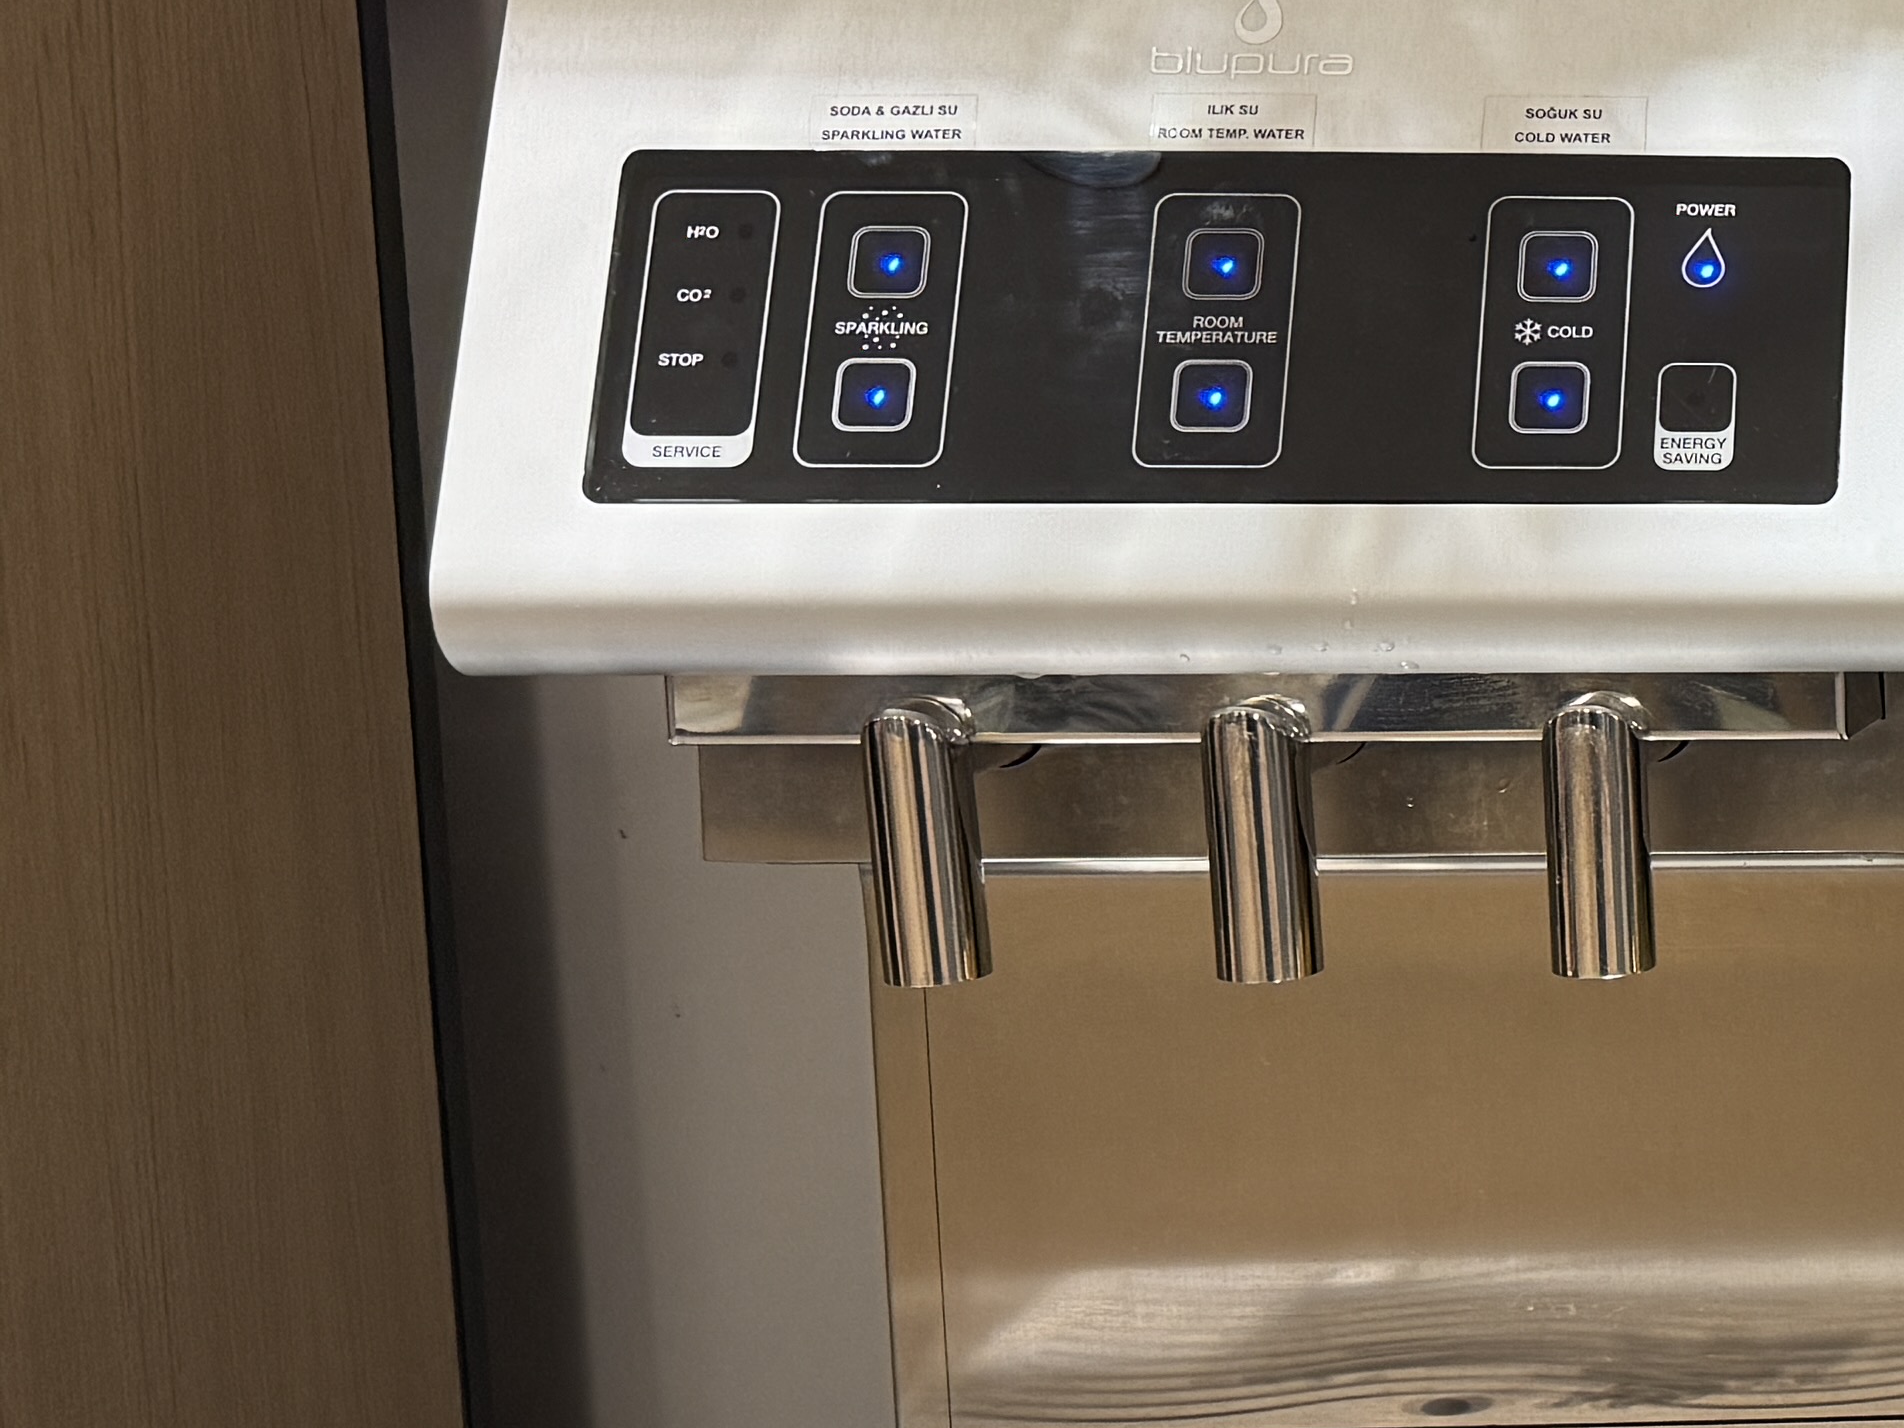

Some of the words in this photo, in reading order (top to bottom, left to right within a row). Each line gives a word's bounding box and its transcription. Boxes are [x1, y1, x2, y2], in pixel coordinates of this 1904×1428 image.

[829, 104, 871, 117] SODA
[874, 104, 886, 117] &
[889, 104, 934, 117] GAZLI
[937, 103, 959, 116] SU
[1207, 103, 1235, 117] ILIK
[1238, 103, 1259, 117] SU
[1524, 105, 1578, 120] SOĞUK
[1581, 107, 1603, 121] SU
[820, 128, 907, 142] SPARKLING
[910, 128, 963, 141] WATER
[1157, 126, 1204, 141] ROOM
[1206, 126, 1250, 141] TEMP.
[1253, 126, 1306, 141] WATER
[1514, 131, 1555, 145] COLD
[1558, 131, 1612, 145] WATER
[1675, 203, 1737, 218] POWER
[834, 321, 930, 337] SPARKLING
[1192, 316, 1245, 330] ROOM
[1155, 330, 1278, 345] TEMPERATURE
[1547, 324, 1594, 339] COLD
[657, 353, 704, 368] STOP
[1659, 436, 1728, 451] ENERGY
[651, 444, 723, 460] SERVICE
[1661, 451, 1723, 466] SAVING
